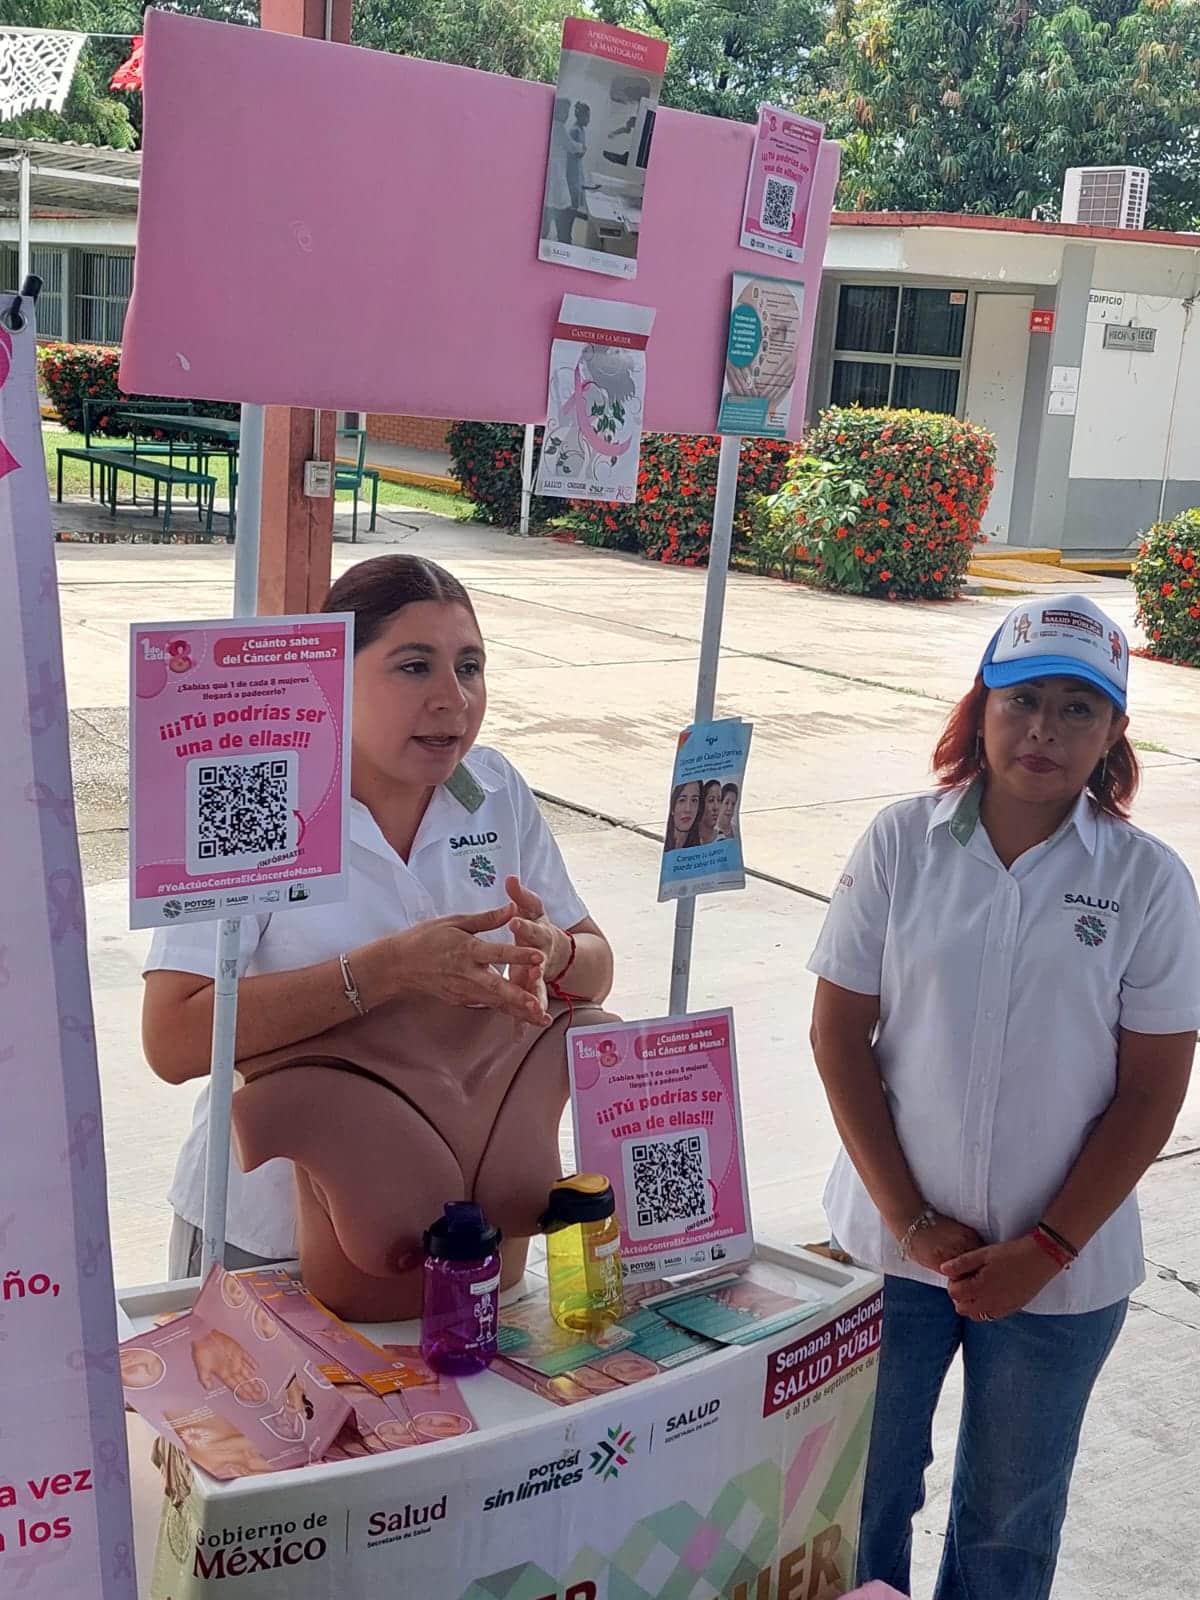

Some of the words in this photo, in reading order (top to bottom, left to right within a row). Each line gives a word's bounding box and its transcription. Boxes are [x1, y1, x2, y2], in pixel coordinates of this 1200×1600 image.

[1089, 295, 1122, 305] EDIFICIO
[1101, 310, 1106, 318] J
[141, 638, 151, 654] 1
[223, 654, 240, 664] del
[243, 651, 281, 663] Cáncer
[284, 649, 298, 660] de
[301, 648, 337, 659] Mama?
[242, 638, 286, 651] ¿Cuánto
[289, 636, 320, 647] sabes
[202, 691, 233, 701] llegará
[242, 688, 286, 699] padecerlo?
[249, 679, 269, 687] cada
[278, 676, 310, 687] mujeres
[160, 712, 207, 740] ¡¡¡Tú
[213, 704, 291, 727] podrías
[296, 707, 326, 723] ser
[176, 738, 212, 757] una
[219, 733, 243, 749] de
[249, 730, 311, 748] ellas!!!
[449, 832, 498, 849] SALUD
[1064, 893, 1120, 913] SALUD
[642, 1049, 656, 1058] del
[658, 1044, 687, 1056] Cáncer
[688, 1042, 698, 1051] de
[700, 1038, 725, 1049] Mama?
[656, 1032, 690, 1046] ¿Cuánto
[691, 1029, 713, 1039] sabes
[597, 1098, 634, 1125] ¡¡¡Tú
[639, 1089, 698, 1111] podrías
[702, 1090, 722, 1103] ser
[611, 1122, 641, 1138] una
[646, 1115, 664, 1130] de
[669, 1110, 714, 1126] ellas!!!
[776, 1331, 831, 1373] Semana
[835, 1290, 883, 1340] Nacional
[773, 1355, 832, 1406] SALUD
[792, 1405, 801, 1416] al
[802, 1399, 811, 1410] 13
[812, 1392, 822, 1403] de
[824, 1365, 864, 1396] septiembre
[666, 1399, 720, 1432] SALUD
[529, 1450, 581, 1480] POTOSÍ
[27, 1469, 92, 1500] vez
[483, 1489, 515, 1511] sin
[367, 1495, 447, 1536] Salud
[18, 1516, 71, 1548] los
[196, 1520, 296, 1547] Gobierno
[303, 1512, 328, 1529] de
[413, 1526, 431, 1536] Salud
[193, 1537, 327, 1579] México
